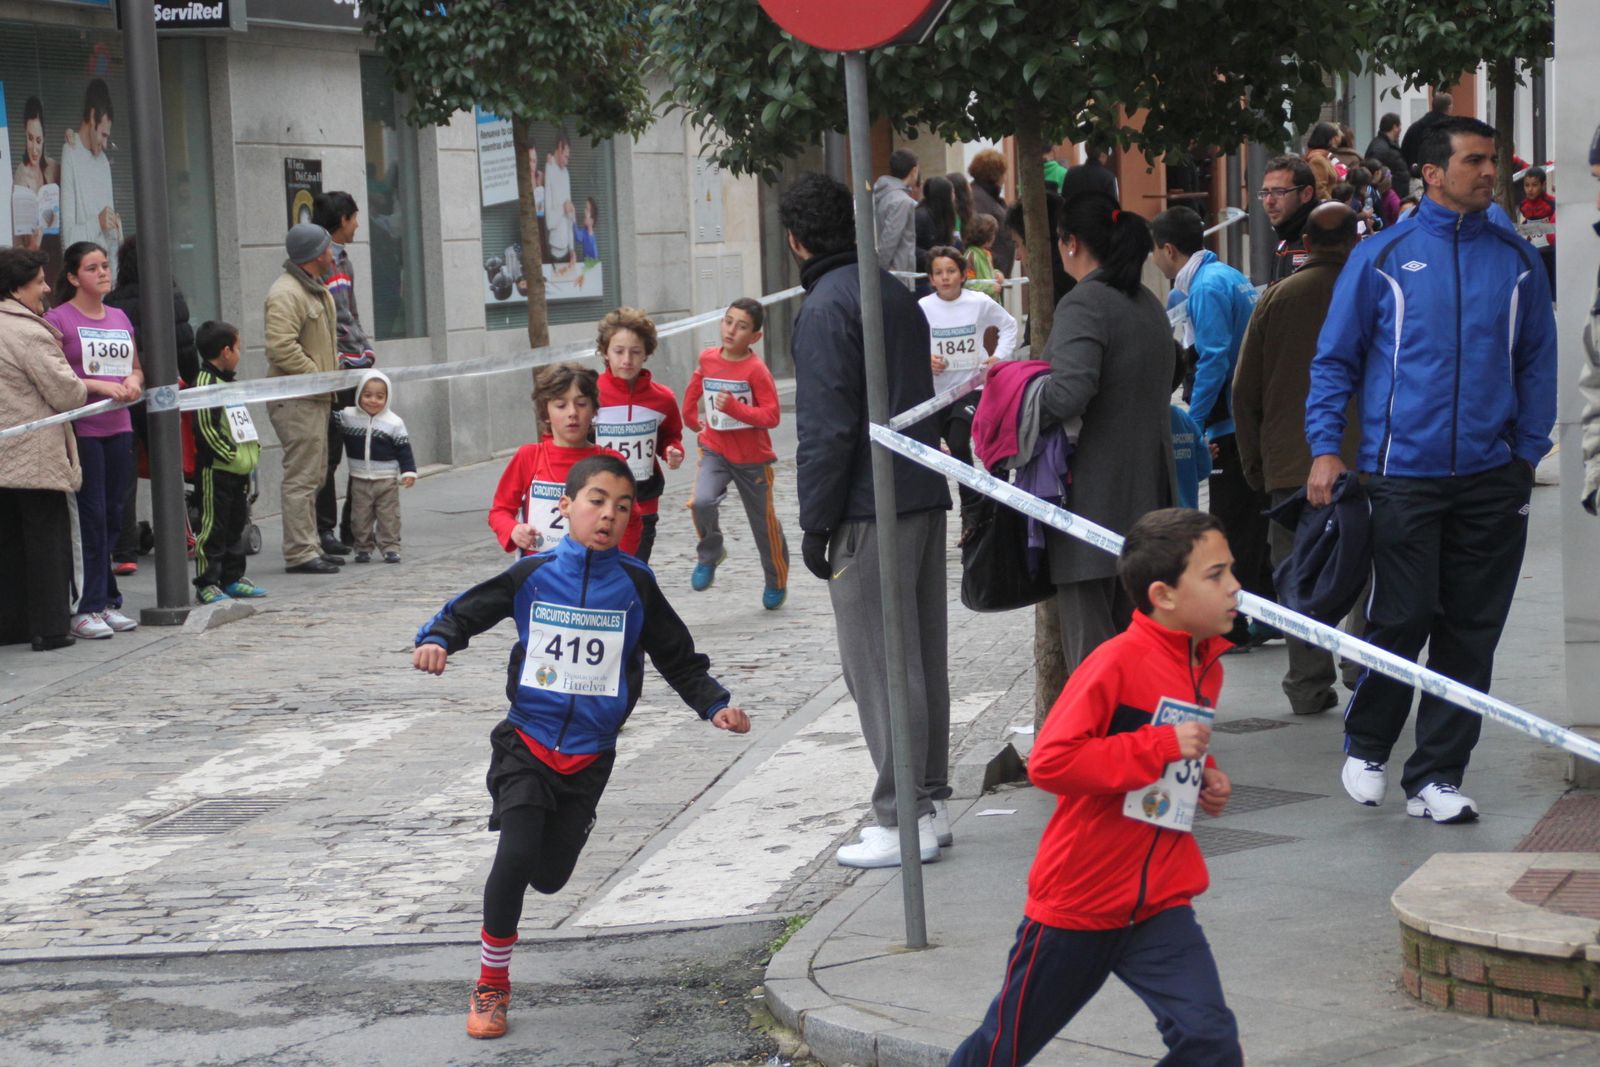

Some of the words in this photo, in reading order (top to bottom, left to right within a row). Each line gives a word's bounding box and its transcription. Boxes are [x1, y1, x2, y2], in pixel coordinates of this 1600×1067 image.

[154, 2, 223, 21] ServiRed
[87, 341, 129, 359] 1360
[936, 338, 976, 356] 1842
[534, 485, 562, 498] CIRCUITOS
[535, 606, 571, 624] CIRCUITOS
[570, 611, 621, 628] PROVINCIALES
[544, 633, 606, 667] 419
[563, 677, 607, 693] Huelva
